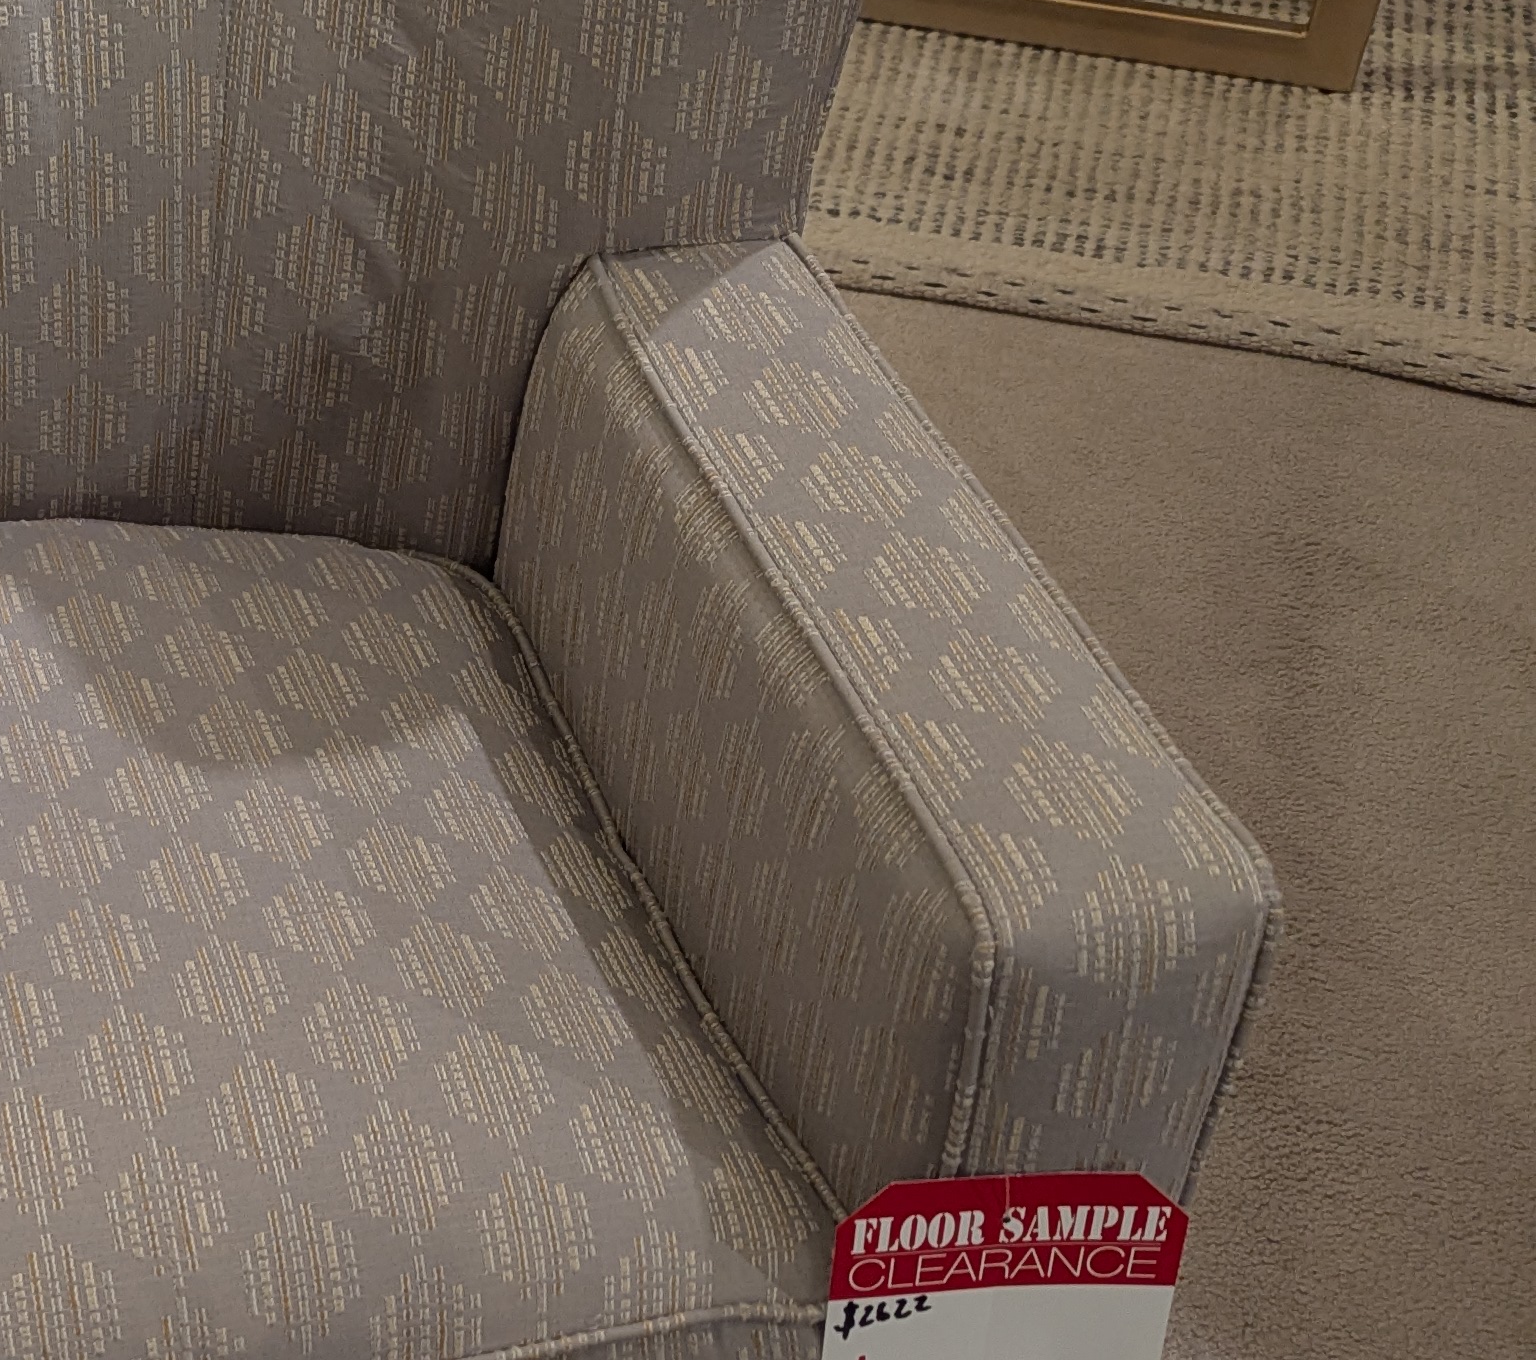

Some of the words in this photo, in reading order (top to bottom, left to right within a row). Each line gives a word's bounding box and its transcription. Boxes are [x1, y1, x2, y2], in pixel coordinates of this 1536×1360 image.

[850, 1209, 985, 1256] FLOOR
[998, 1205, 1172, 1244] SAMPLE
[848, 1245, 1162, 1292] CLEARANCE
